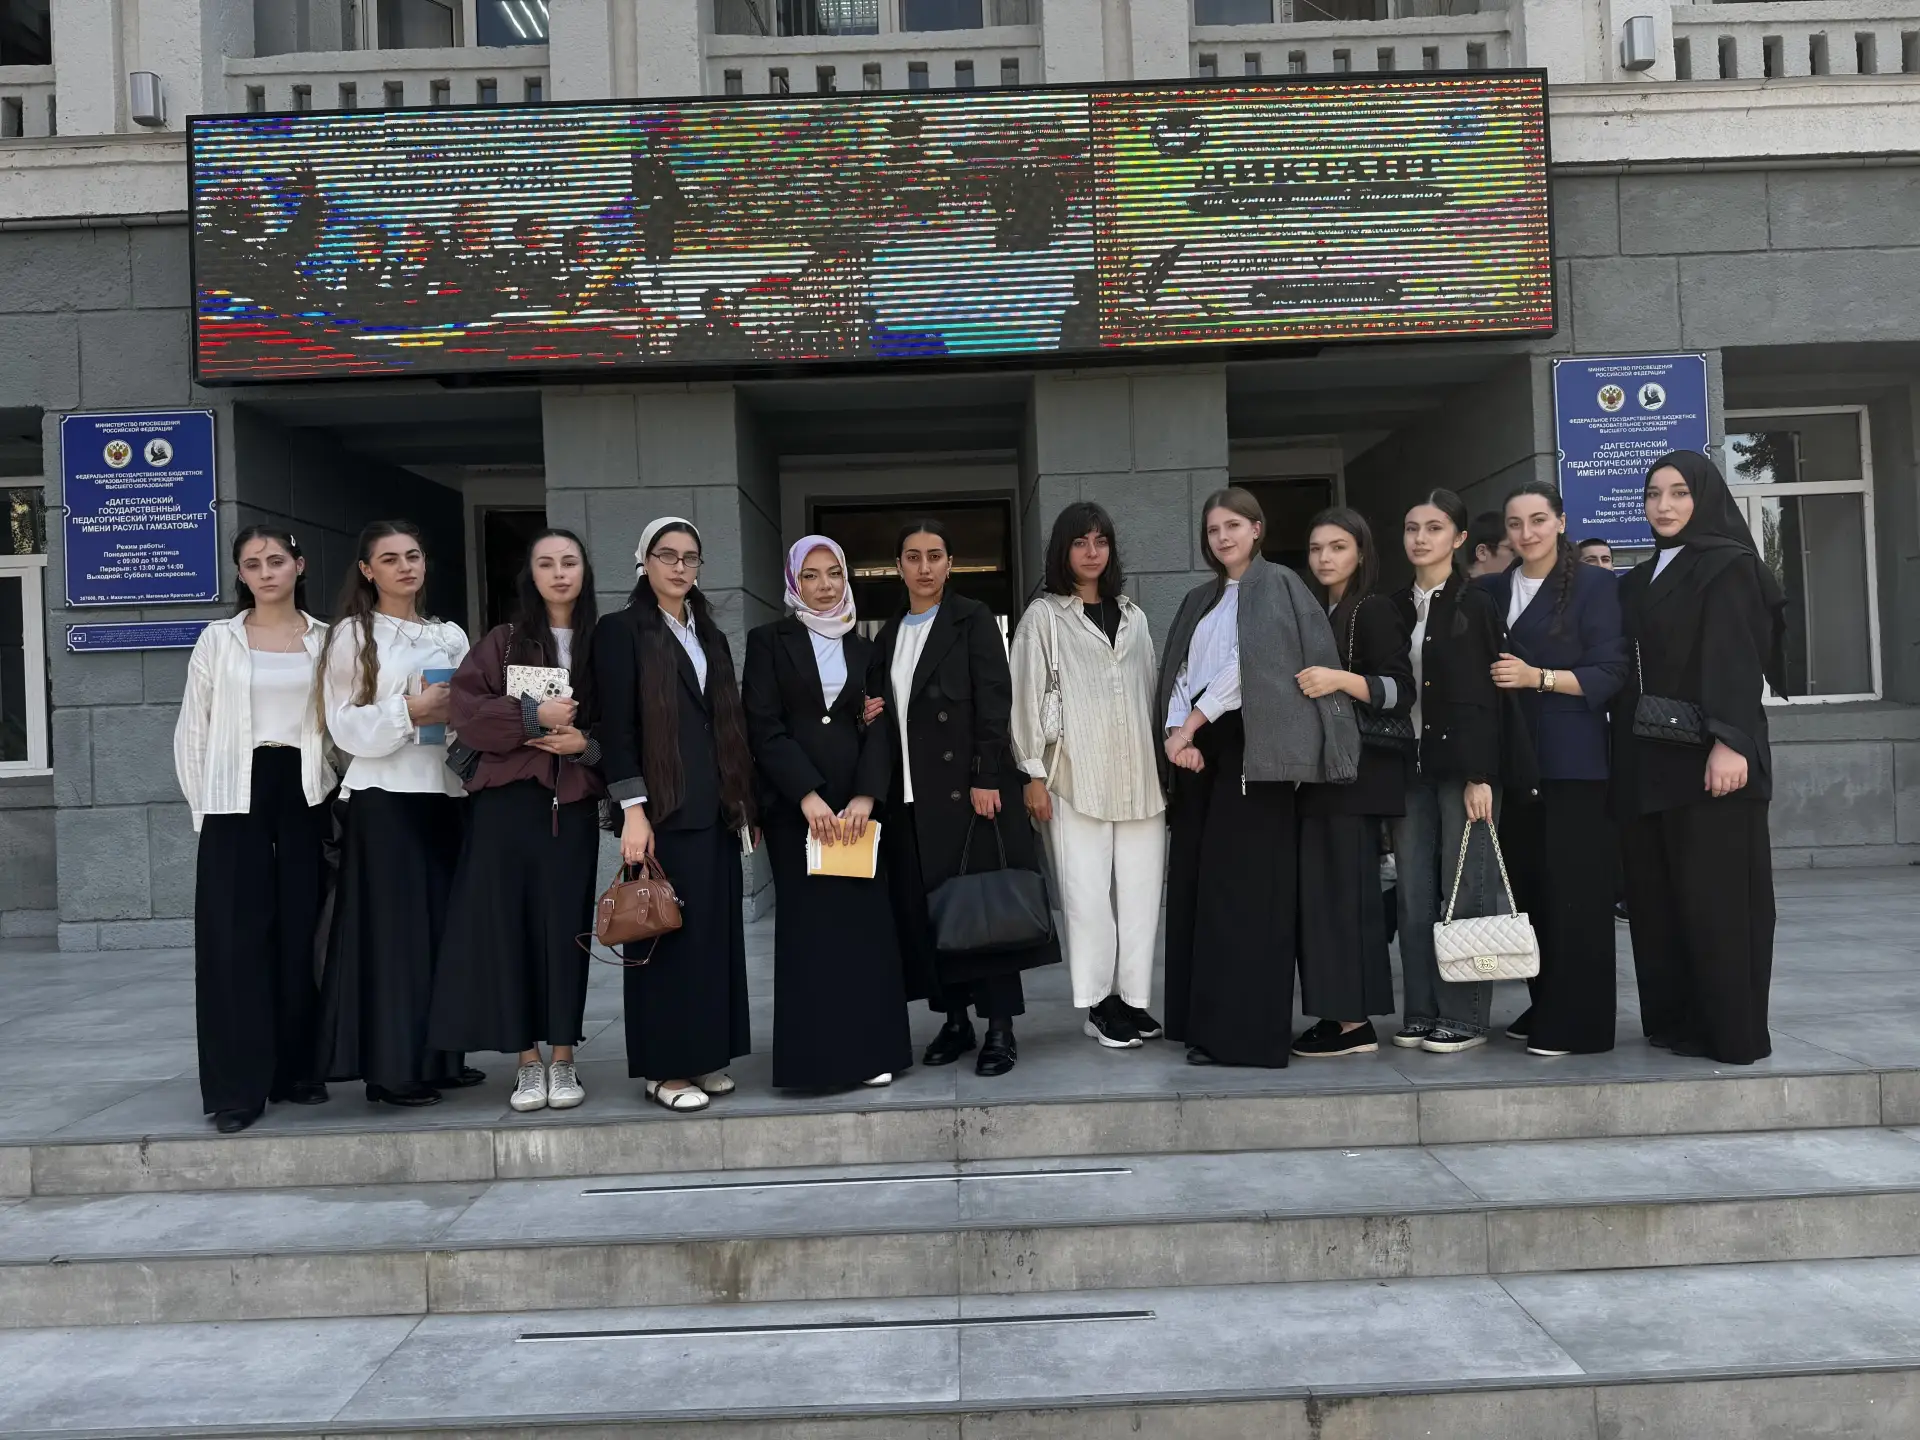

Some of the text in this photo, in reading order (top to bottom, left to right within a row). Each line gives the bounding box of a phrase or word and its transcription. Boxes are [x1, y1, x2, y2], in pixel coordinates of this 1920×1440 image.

[1600, 439, 1668, 450] «ДАГЕСТАНСКИЙ
[1568, 458, 1642, 469] ПЕДАГОГИЧЕСКИЙ
[105, 495, 173, 506] «ДАГЕСТАНСКИЙ
[98, 504, 181, 515] ГОСУДАРСТВЕННЫЙ
[73, 513, 208, 525] ПЕДАГОГИЧЕСКИЙ УНИВЕРСИТЕТ
[113, 524, 144, 532] РАСУЛА
[146, 522, 198, 530] ГАМЗАТОВА»
